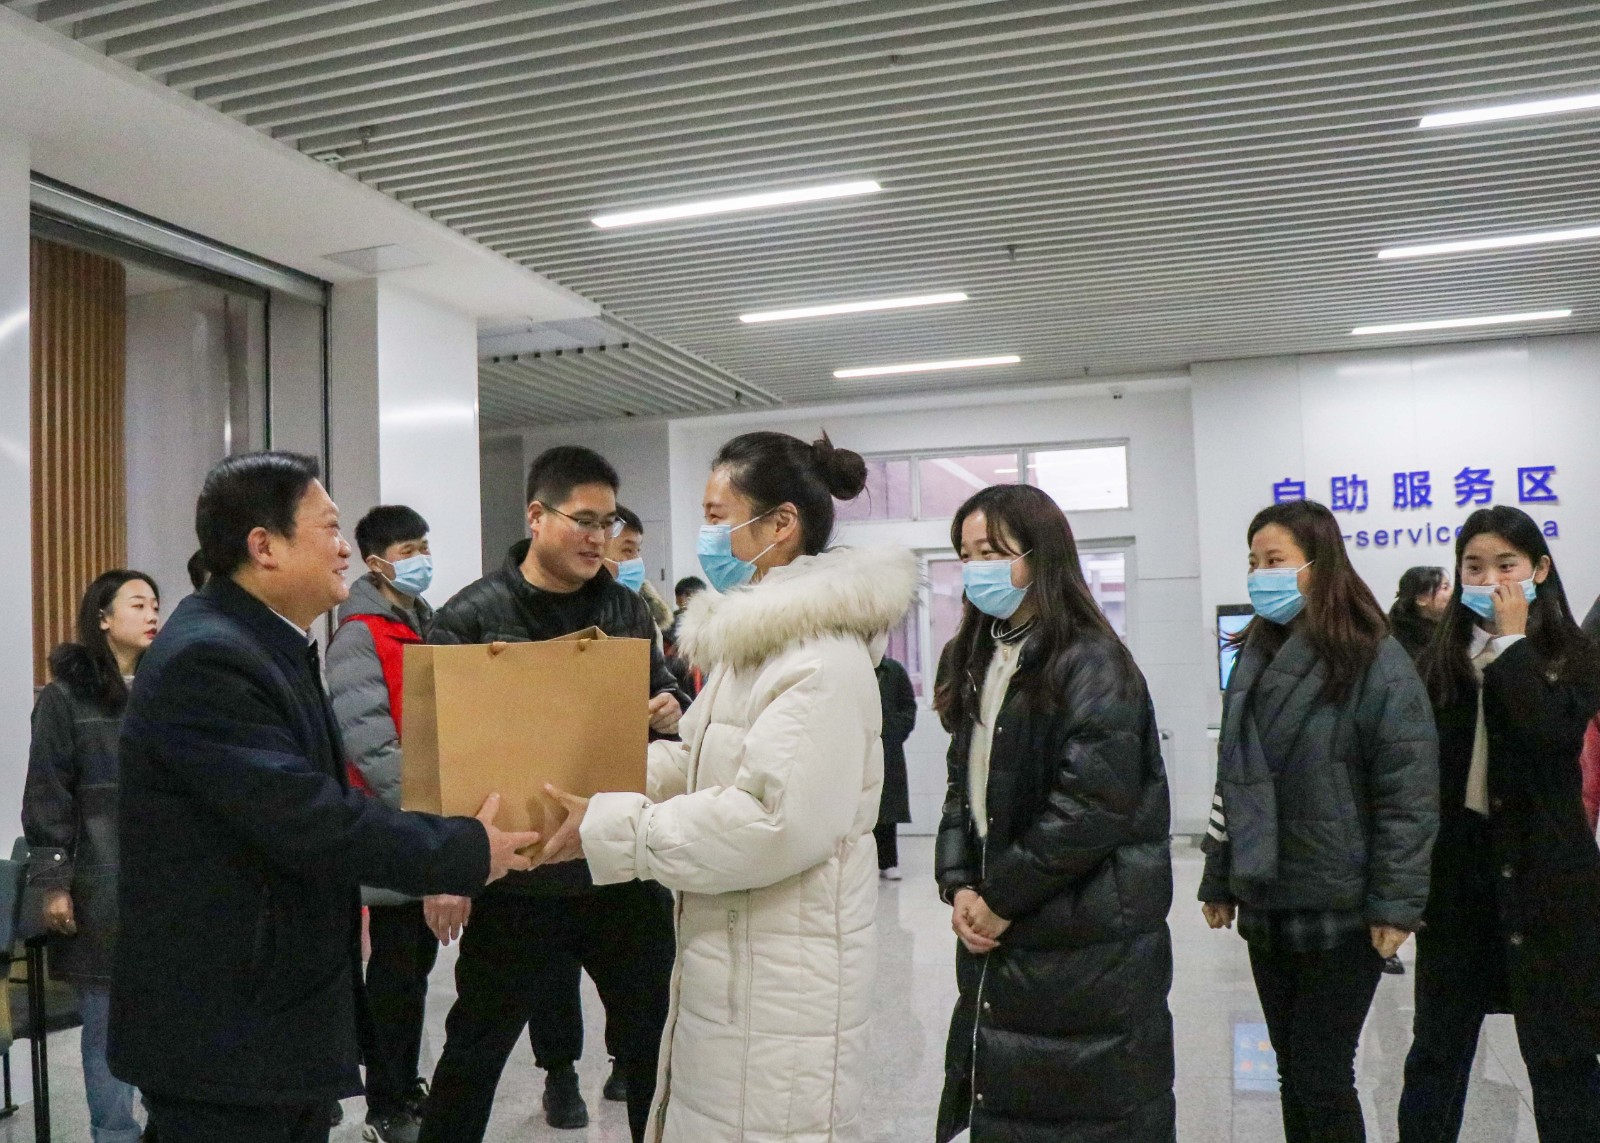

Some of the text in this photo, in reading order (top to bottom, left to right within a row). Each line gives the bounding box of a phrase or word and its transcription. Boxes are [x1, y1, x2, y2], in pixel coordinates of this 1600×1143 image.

[1273, 466, 1558, 511] 自助服务区
